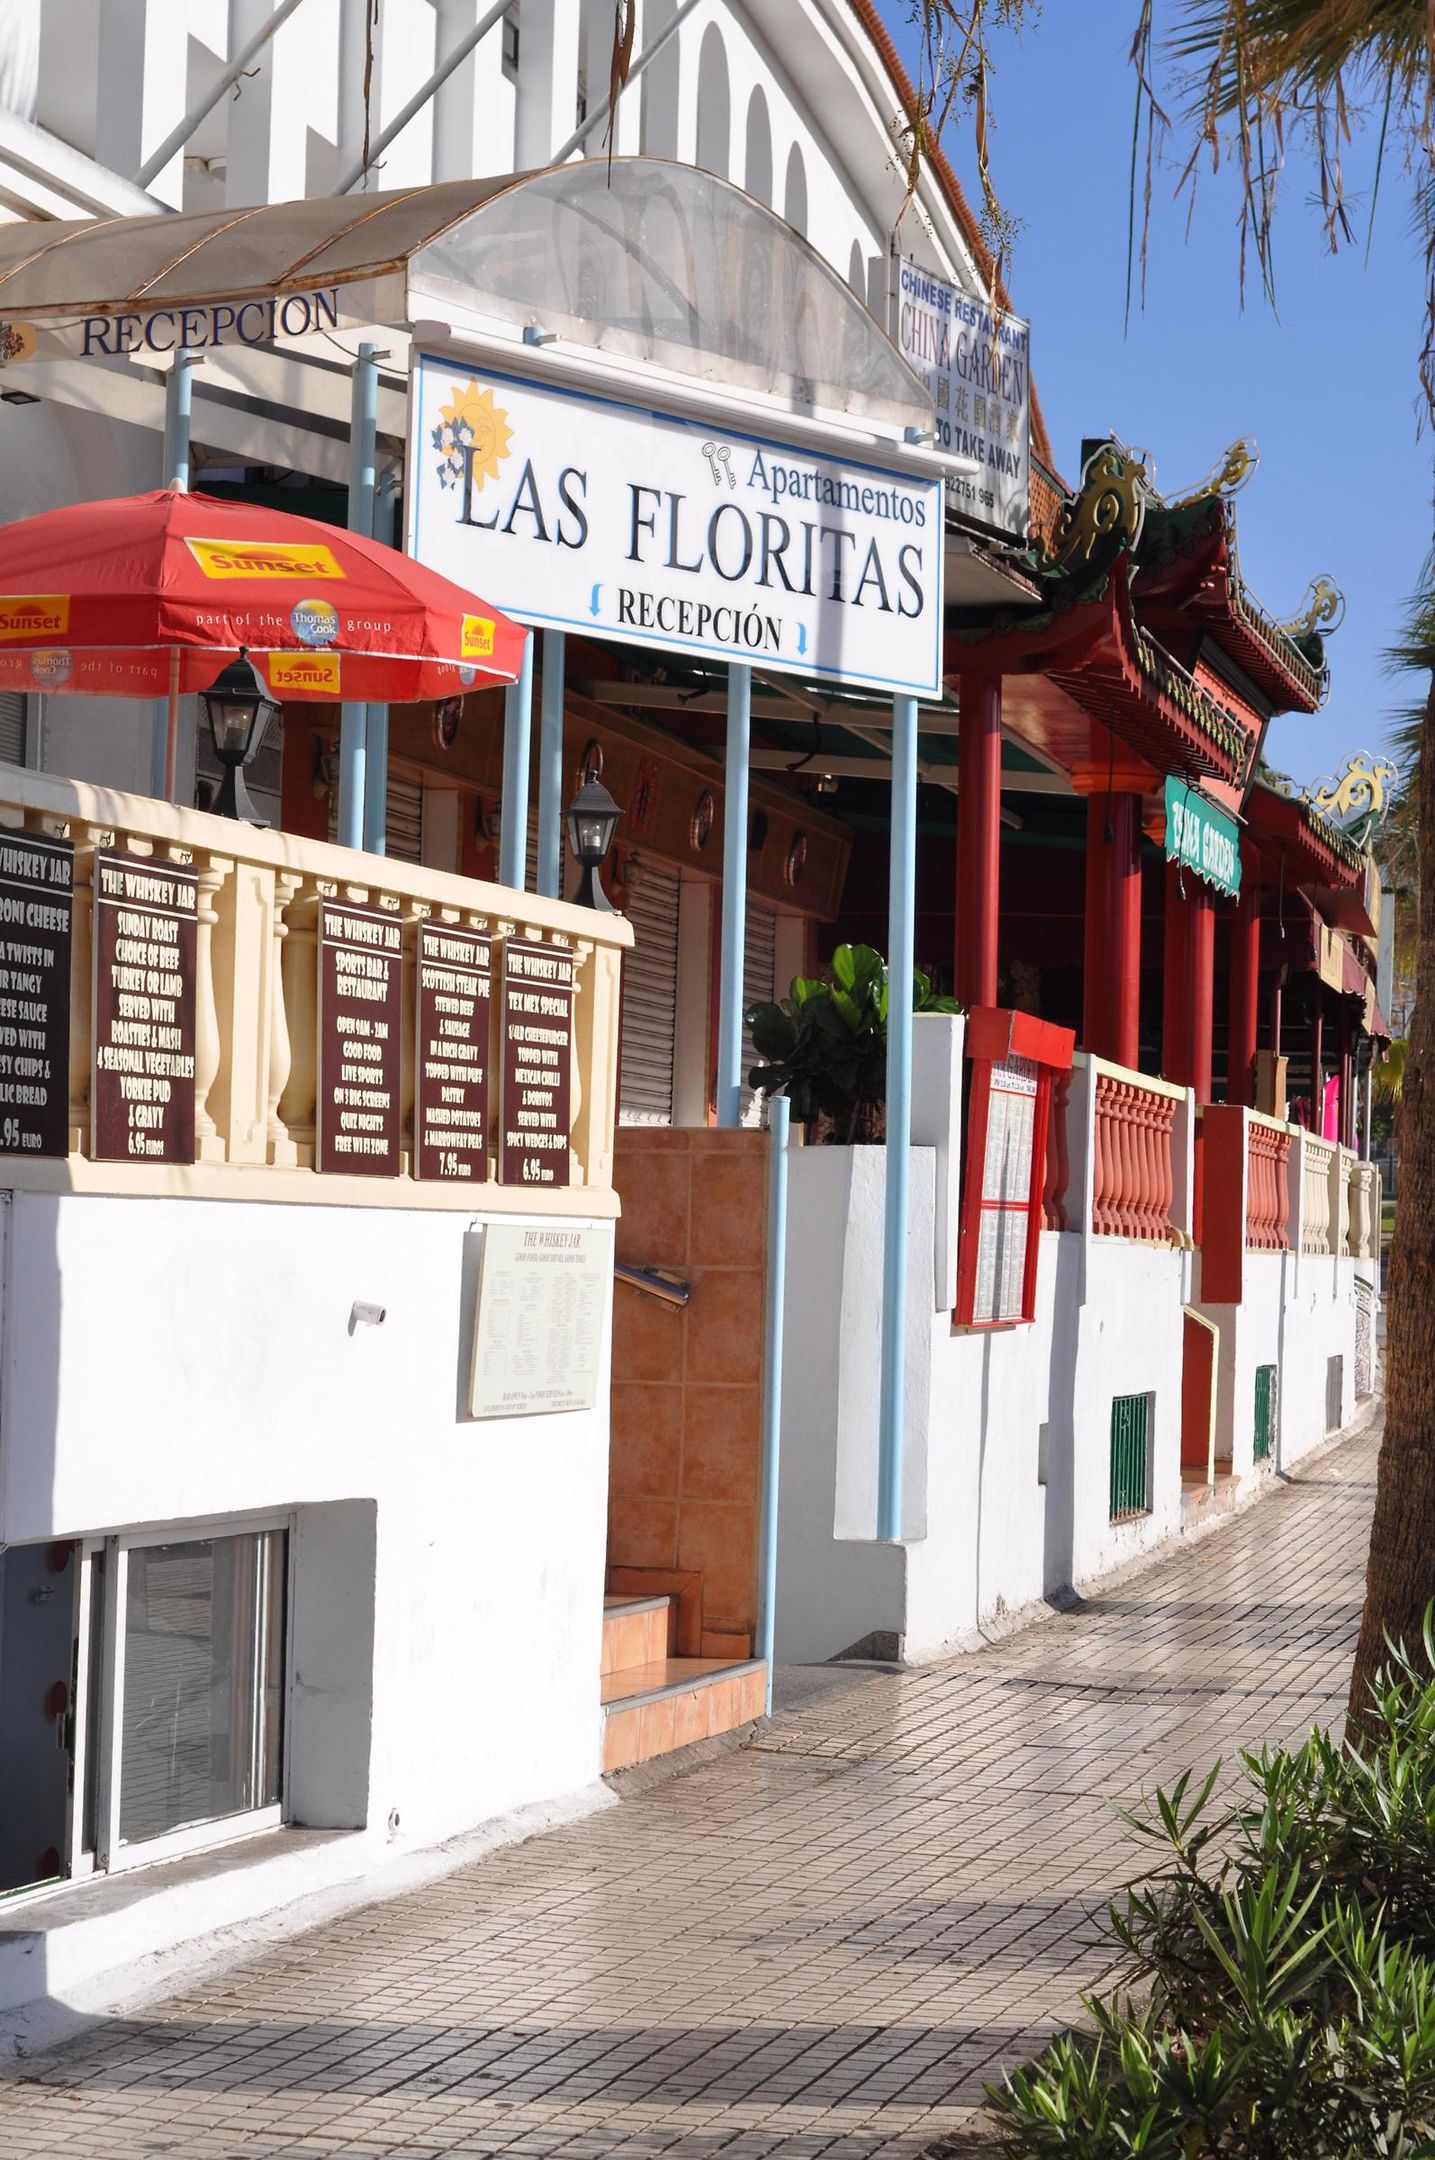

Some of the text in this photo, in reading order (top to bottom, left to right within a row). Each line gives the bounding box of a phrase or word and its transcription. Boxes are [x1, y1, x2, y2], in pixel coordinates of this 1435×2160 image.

[901, 269, 951, 315] CHINESE
[901, 302, 1023, 406] CHINA GARDEN
[936, 418, 1021, 479] TO TAKE AWAY
[747, 449, 926, 528] Apartamentos
[455, 445, 925, 620] LAS FLORITAS
[209, 554, 332, 574] Sunset
[0, 613, 62, 630] Sunset
[196, 613, 284, 627] part of the
[294, 612, 337, 625] Thomas
[310, 623, 336, 635] Cook
[347, 620, 392, 634] group
[617, 588, 783, 652] RECEPCIÓN
[465, 631, 491, 651] Sunset
[49, 858, 71, 886] JAR
[101, 868, 196, 910] THE WHISKEY JAR
[26, 903, 70, 933] CHEESE
[117, 911, 179, 943] SUNDAY ROAST
[324, 913, 401, 950] THE WHISKEY JAR
[6, 942, 43, 967] TWISTS
[44, 949, 55, 968] IN
[115, 938, 180, 970] CHOICE OF BEEF
[423, 934, 490, 967] THE WHISKEY JAR
[335, 951, 390, 981] SPORTS BAR &
[507, 953, 572, 982] THE WHISKEY JAR
[10, 971, 43, 994] TANGY
[111, 965, 183, 998] TURKEY OR LAMB
[336, 974, 388, 1003] RESTAURANT
[422, 968, 491, 998] SCOTTISH STEAK PIE
[0, 998, 48, 1023] ESE SAUCE
[118, 993, 176, 1023] SERVED WITH
[435, 995, 475, 1016] STEWED BEEF
[508, 991, 569, 1018] TEX MEX SPECIAL
[0, 1026, 46, 1051] VED WITH
[111, 1020, 182, 1050] ROASTIES & MASH
[336, 1016, 356, 1034] OPEN
[355, 1018, 371, 1037] 9AM
[374, 1022, 389, 1040] 2AM
[444, 1019, 471, 1038] SAUSAGE
[524, 1026, 569, 1046] CHEESEBURGER
[97, 1046, 195, 1079] 4 SEASONAL VEGETABLES
[342, 1040, 382, 1062] GOOD FOOD
[458, 1044, 479, 1061] GRAVY
[517, 1046, 559, 1066] TOPPED WITH
[14, 1057, 43, 1078] CHIPS
[44, 1060, 51, 1079] &
[341, 1064, 384, 1085] LIVE SPORTS
[425, 1062, 483, 1083] TOPPED WITH PUFF
[515, 1068, 541, 1084] MEXICAN
[0, 1083, 48, 1106] LIC BREAD
[120, 1075, 171, 1103] YORKIE PUD
[333, 1086, 344, 1104] ON
[349, 1088, 362, 1106] BIG
[362, 1090, 391, 1109] SCREENS
[441, 1086, 465, 1104] PASTRY
[527, 1090, 553, 1107] DORITOS
[128, 1104, 165, 1129] & GRAVY
[340, 1111, 384, 1132] QUIZ NIGHTS
[426, 1107, 481, 1127] MASHED POTATOES
[517, 1110, 557, 1128] SERVED WITH
[0, 1118, 43, 1149] .95 EURO
[128, 1131, 165, 1156] 6.95 EUROS
[334, 1135, 353, 1152] FREE
[371, 1138, 389, 1155] ZONE
[467, 1133, 483, 1150] PEAS
[506, 1131, 524, 1148] SPICY
[524, 1132, 549, 1149] WEDGES
[439, 1151, 458, 1176] 7.95
[522, 1158, 541, 1181] 6.95
[523, 1231, 581, 1248] THE WHISKEY JAR
